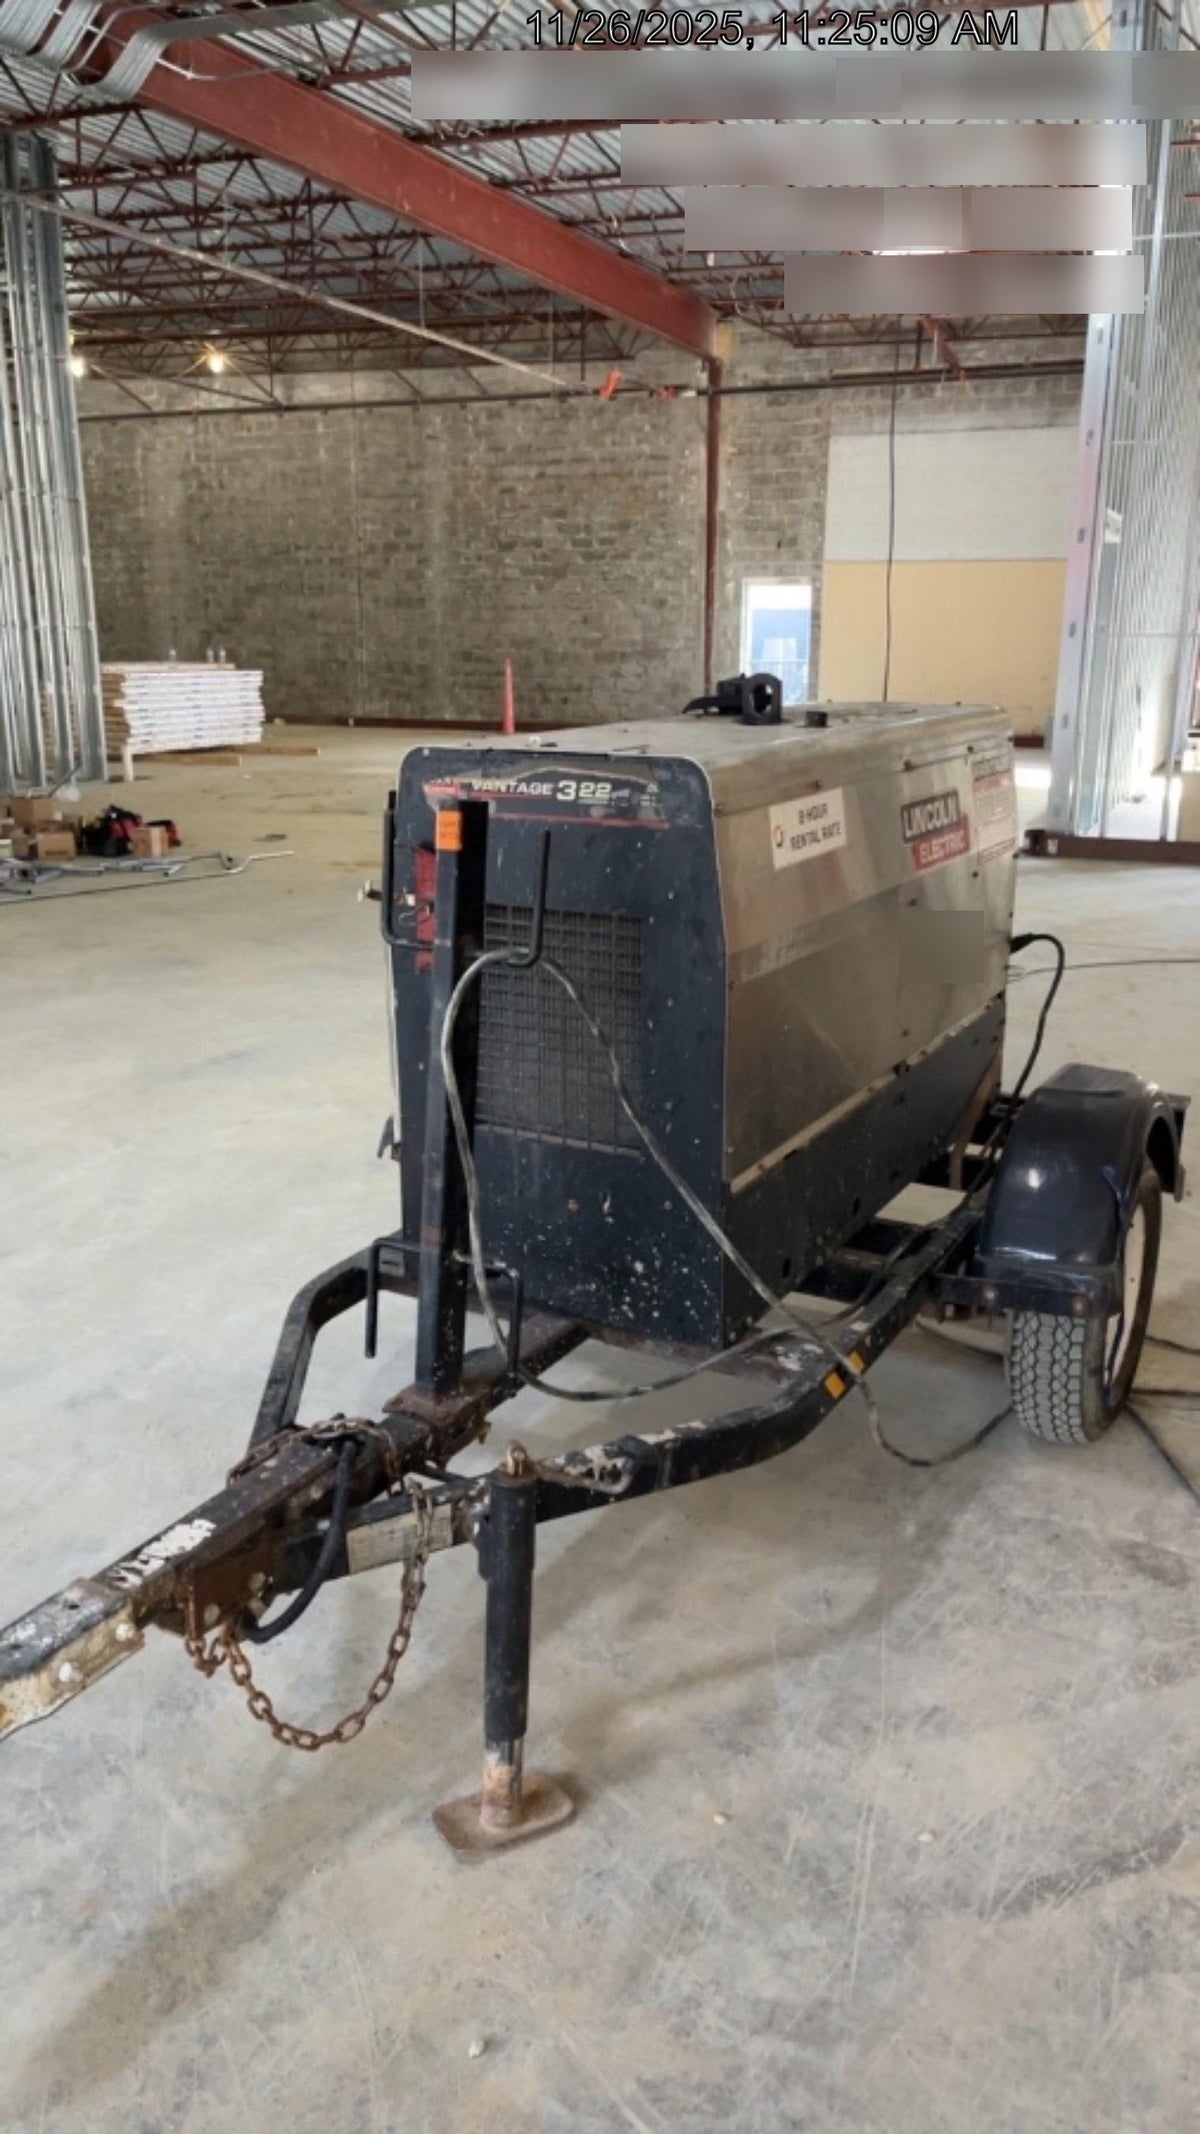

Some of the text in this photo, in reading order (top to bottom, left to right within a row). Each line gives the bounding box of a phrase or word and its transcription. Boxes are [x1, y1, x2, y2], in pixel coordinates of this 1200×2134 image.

[470, 781, 553, 796] VANTAGE
[556, 780, 612, 801] 322
[902, 795, 958, 840] LINCOLN
[789, 828, 821, 852] RENTAL
[917, 829, 966, 865] ELECTRIC
